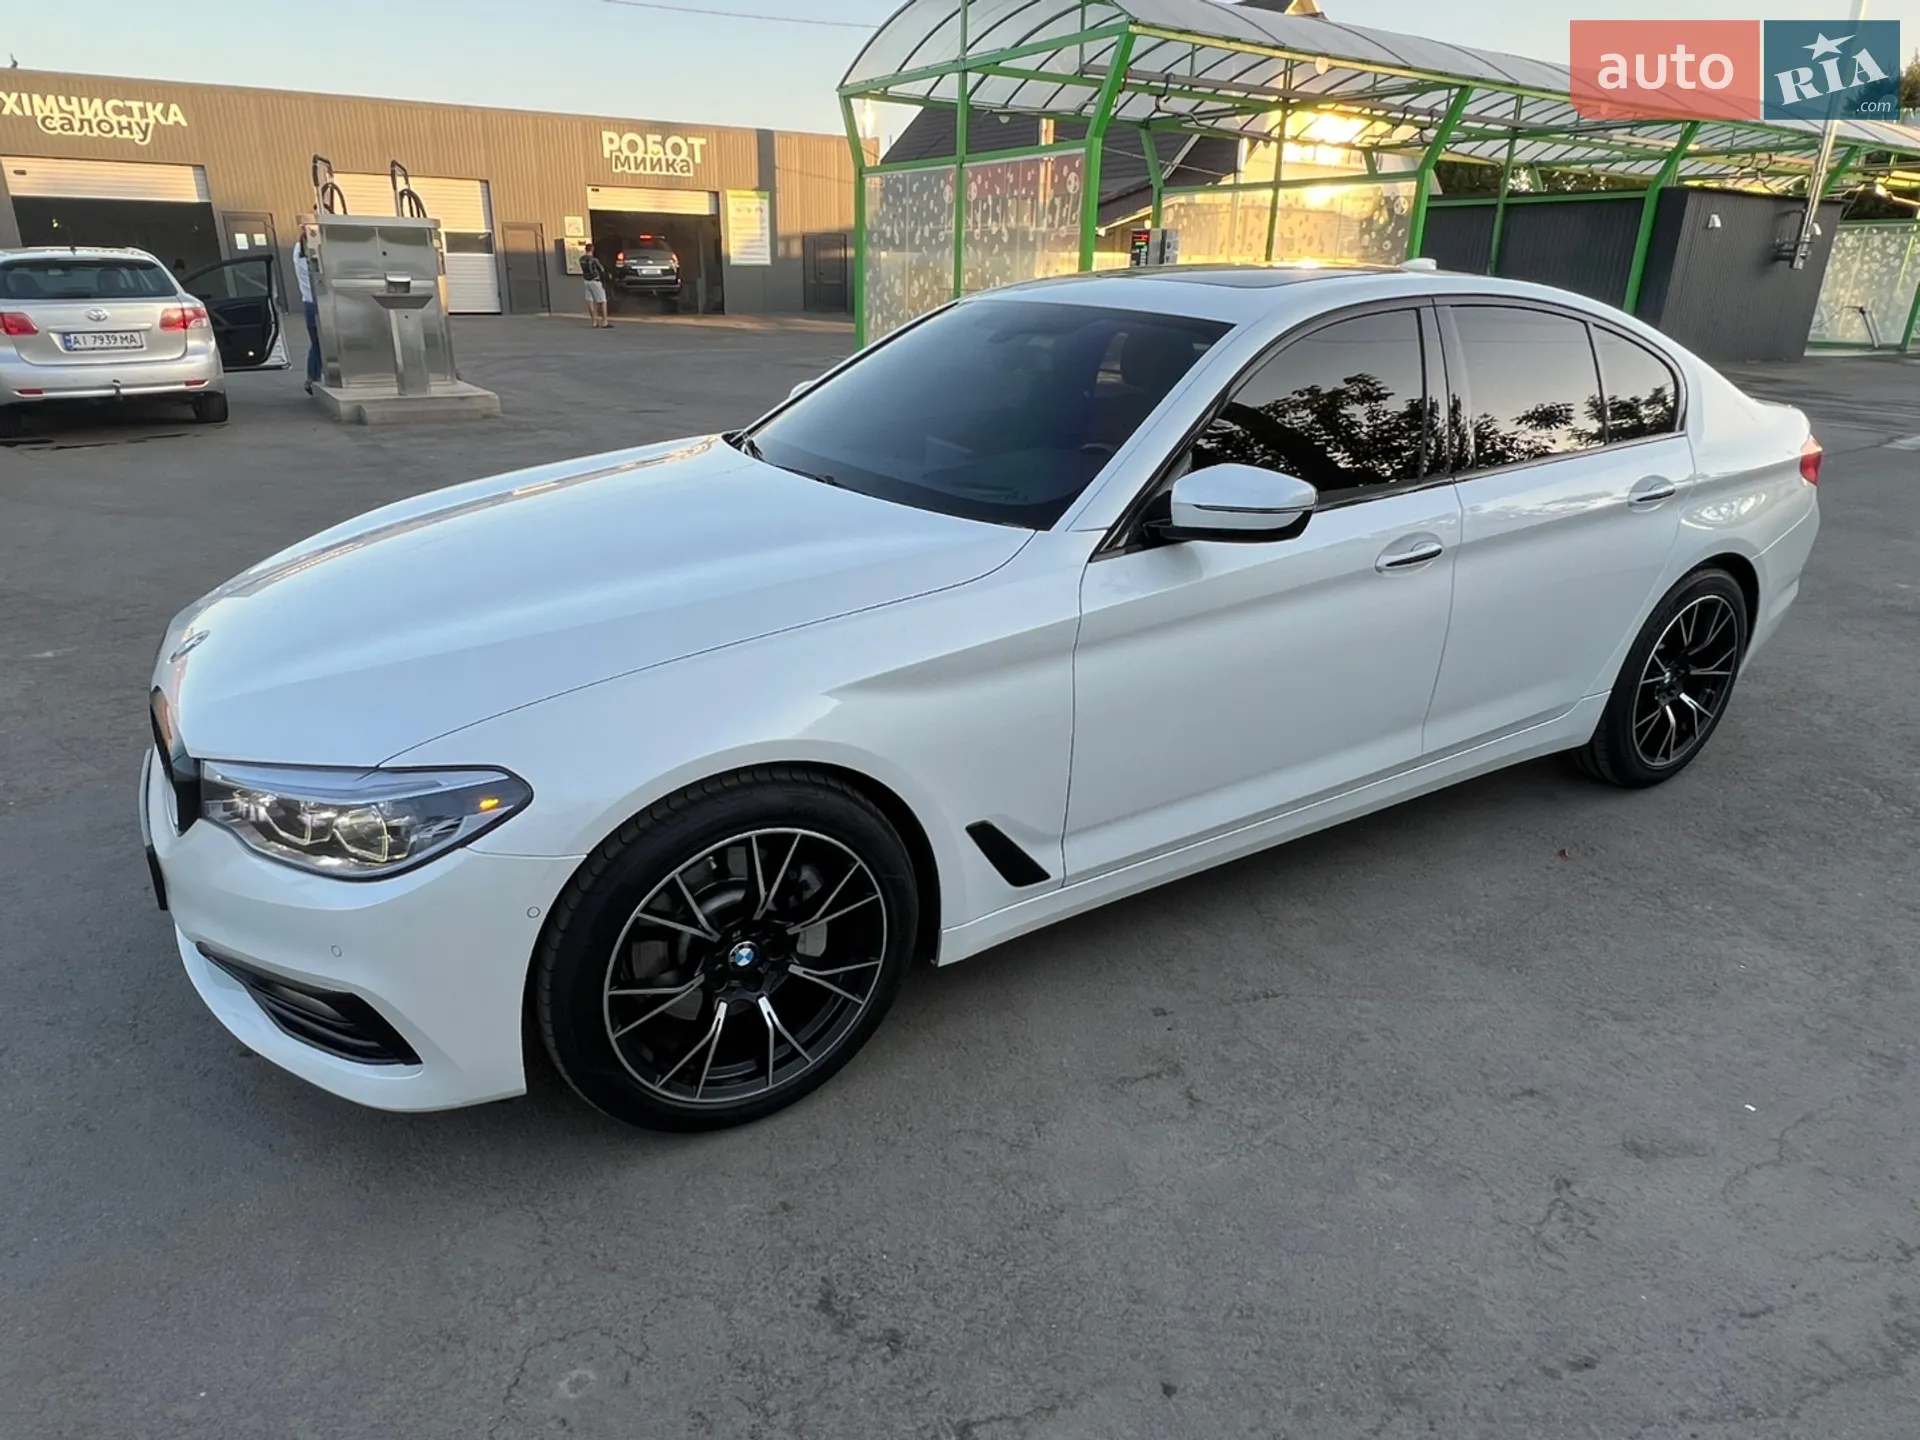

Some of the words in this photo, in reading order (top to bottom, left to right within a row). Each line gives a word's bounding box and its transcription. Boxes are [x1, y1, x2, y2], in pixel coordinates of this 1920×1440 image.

[0, 91, 187, 127] ХІМЧИСТКА
[38, 114, 153, 145] салону
[601, 131, 706, 164] РОБОТ
[91, 334, 118, 345] 7939
[120, 333, 137, 344] MA
